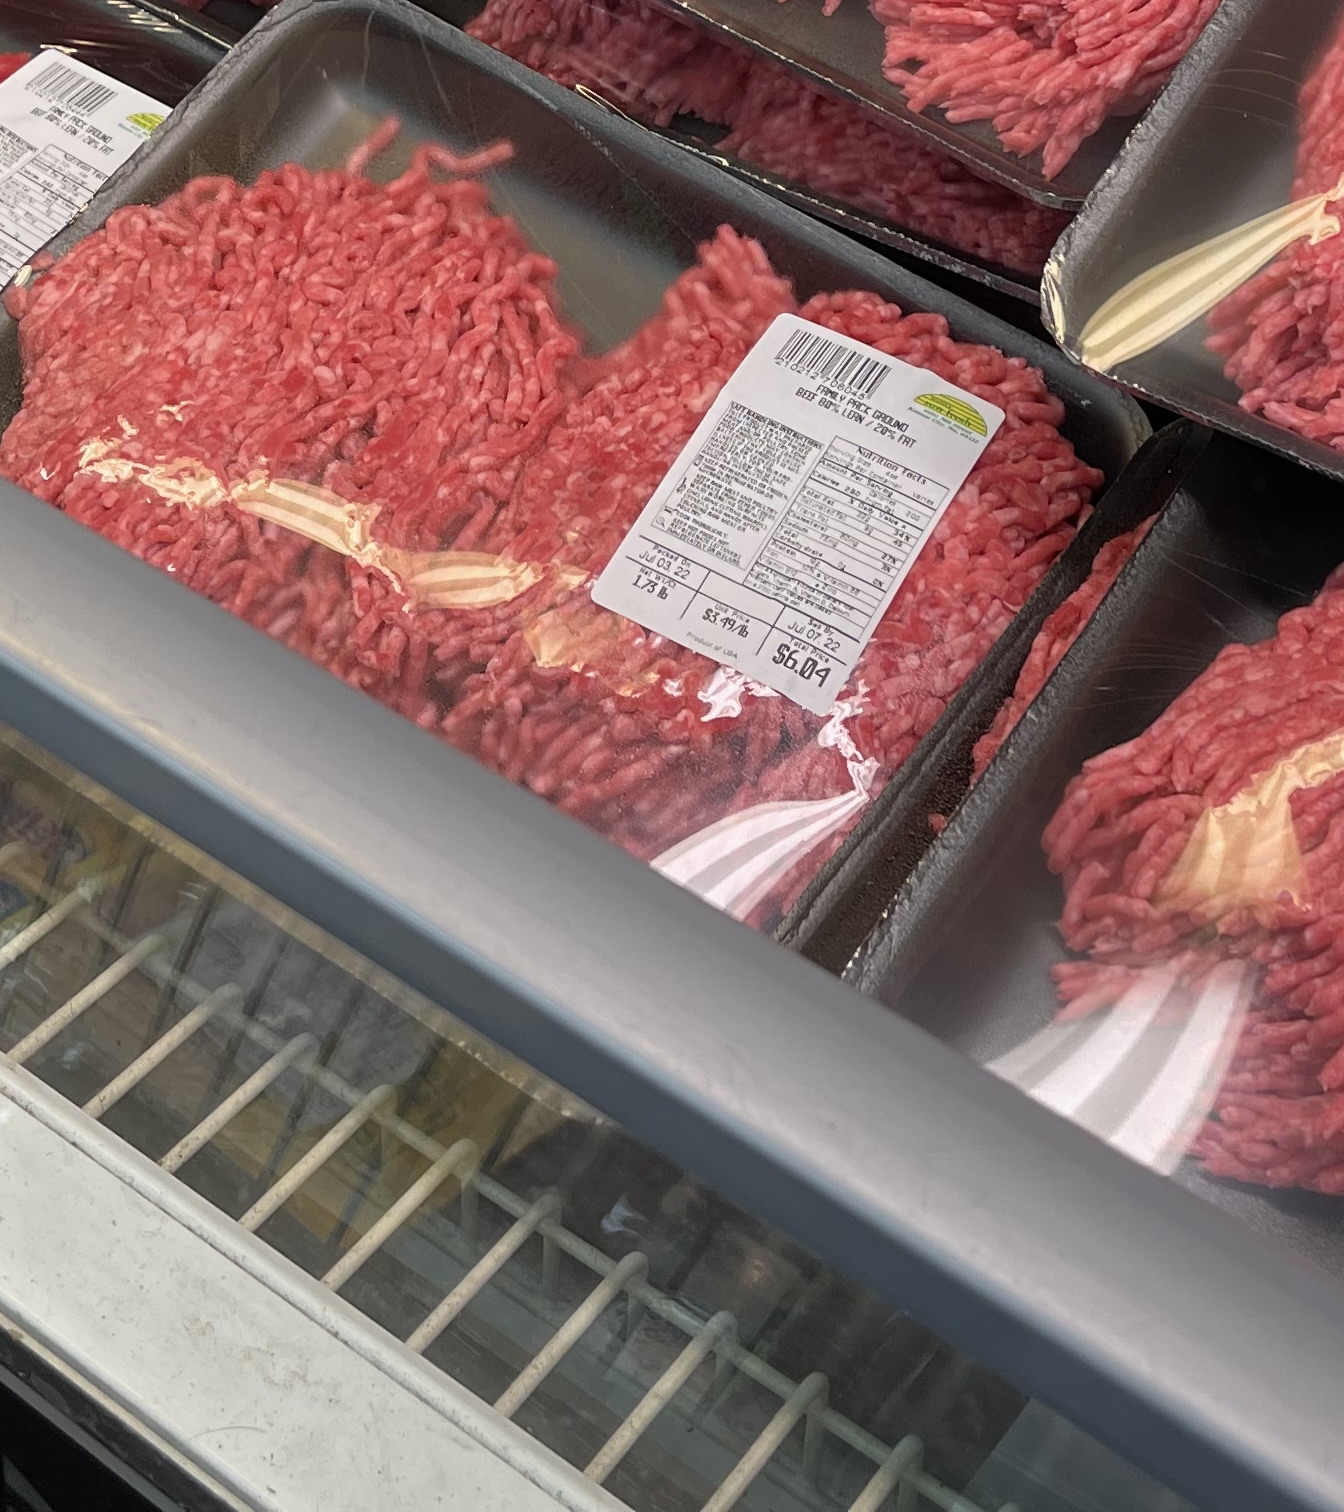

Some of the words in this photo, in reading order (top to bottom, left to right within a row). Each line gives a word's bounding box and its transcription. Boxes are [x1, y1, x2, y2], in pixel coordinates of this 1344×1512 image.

[795, 387, 815, 402] BEEF
[817, 397, 840, 415] 80%
[841, 408, 864, 426] LEAN
[874, 422, 897, 441] 20%
[897, 433, 917, 449] FAT
[816, 383, 847, 403] FAMILY
[847, 397, 872, 415] PACK
[873, 409, 910, 434] GROUND
[857, 445, 899, 472] Nutrition
[902, 467, 927, 486] Facts
[638, 550, 656, 565] Jul
[673, 567, 691, 581] 22
[652, 544, 682, 562] Packed
[631, 574, 656, 595] 1.73
[702, 607, 749, 638] $3.49/lb
[787, 622, 805, 635] Jul
[823, 639, 841, 654] 22
[686, 630, 713, 648] Product
[772, 643, 832, 688] $6.04
[810, 649, 830, 664] Price
